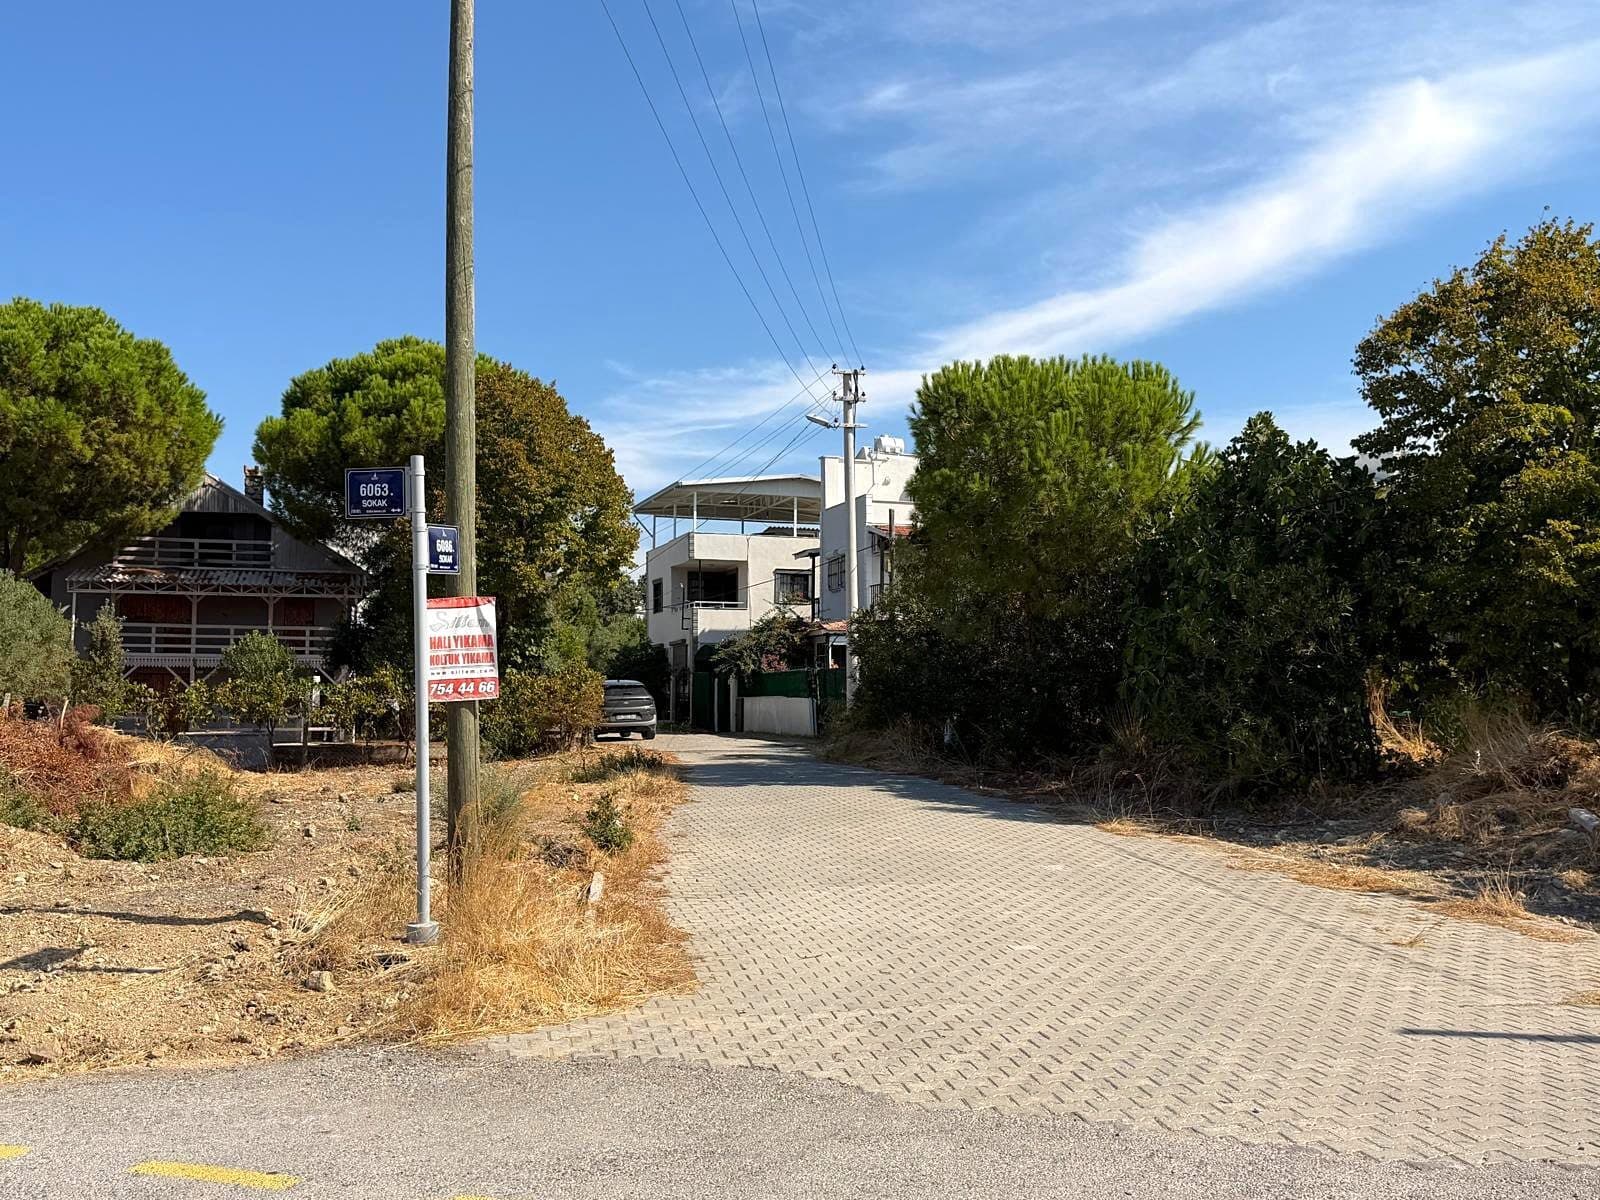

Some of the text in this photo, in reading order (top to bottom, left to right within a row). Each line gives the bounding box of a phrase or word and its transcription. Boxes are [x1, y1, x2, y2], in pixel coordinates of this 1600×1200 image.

[360, 483, 394, 496] 6063.
[362, 498, 388, 508] SOKAK
[438, 554, 453, 564] SOKAK
[453, 634, 494, 649] YIKAMA
[430, 651, 495, 666] KOLTUK YIKAMA
[430, 681, 495, 695] 754 44 66
